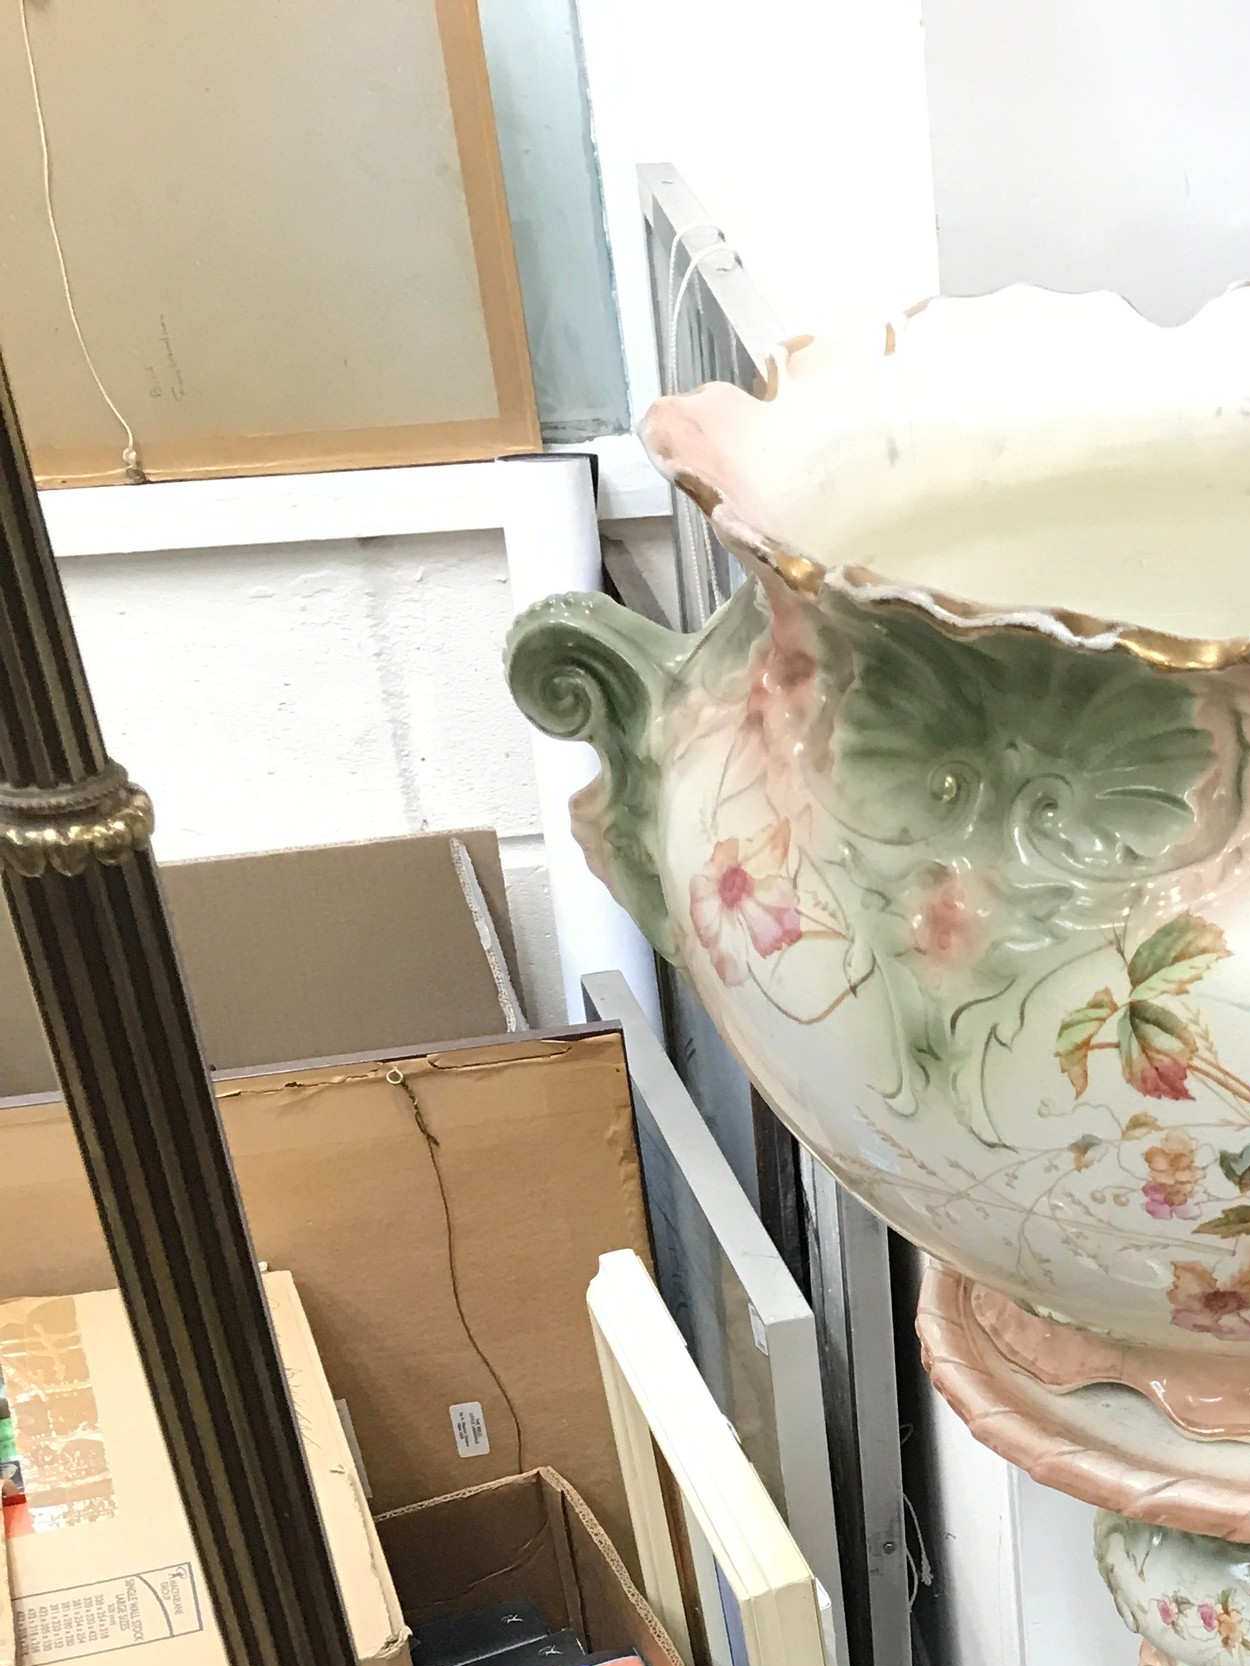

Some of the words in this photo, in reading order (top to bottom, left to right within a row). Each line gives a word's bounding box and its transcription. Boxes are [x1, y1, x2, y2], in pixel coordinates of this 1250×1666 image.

[124, 1578, 137, 1601] SINGLE
[114, 1592, 127, 1614] LARGE
[128, 1601, 140, 1619] WALL
[118, 1614, 130, 1631] SIZES
[131, 1619, 144, 1641] STOCK
